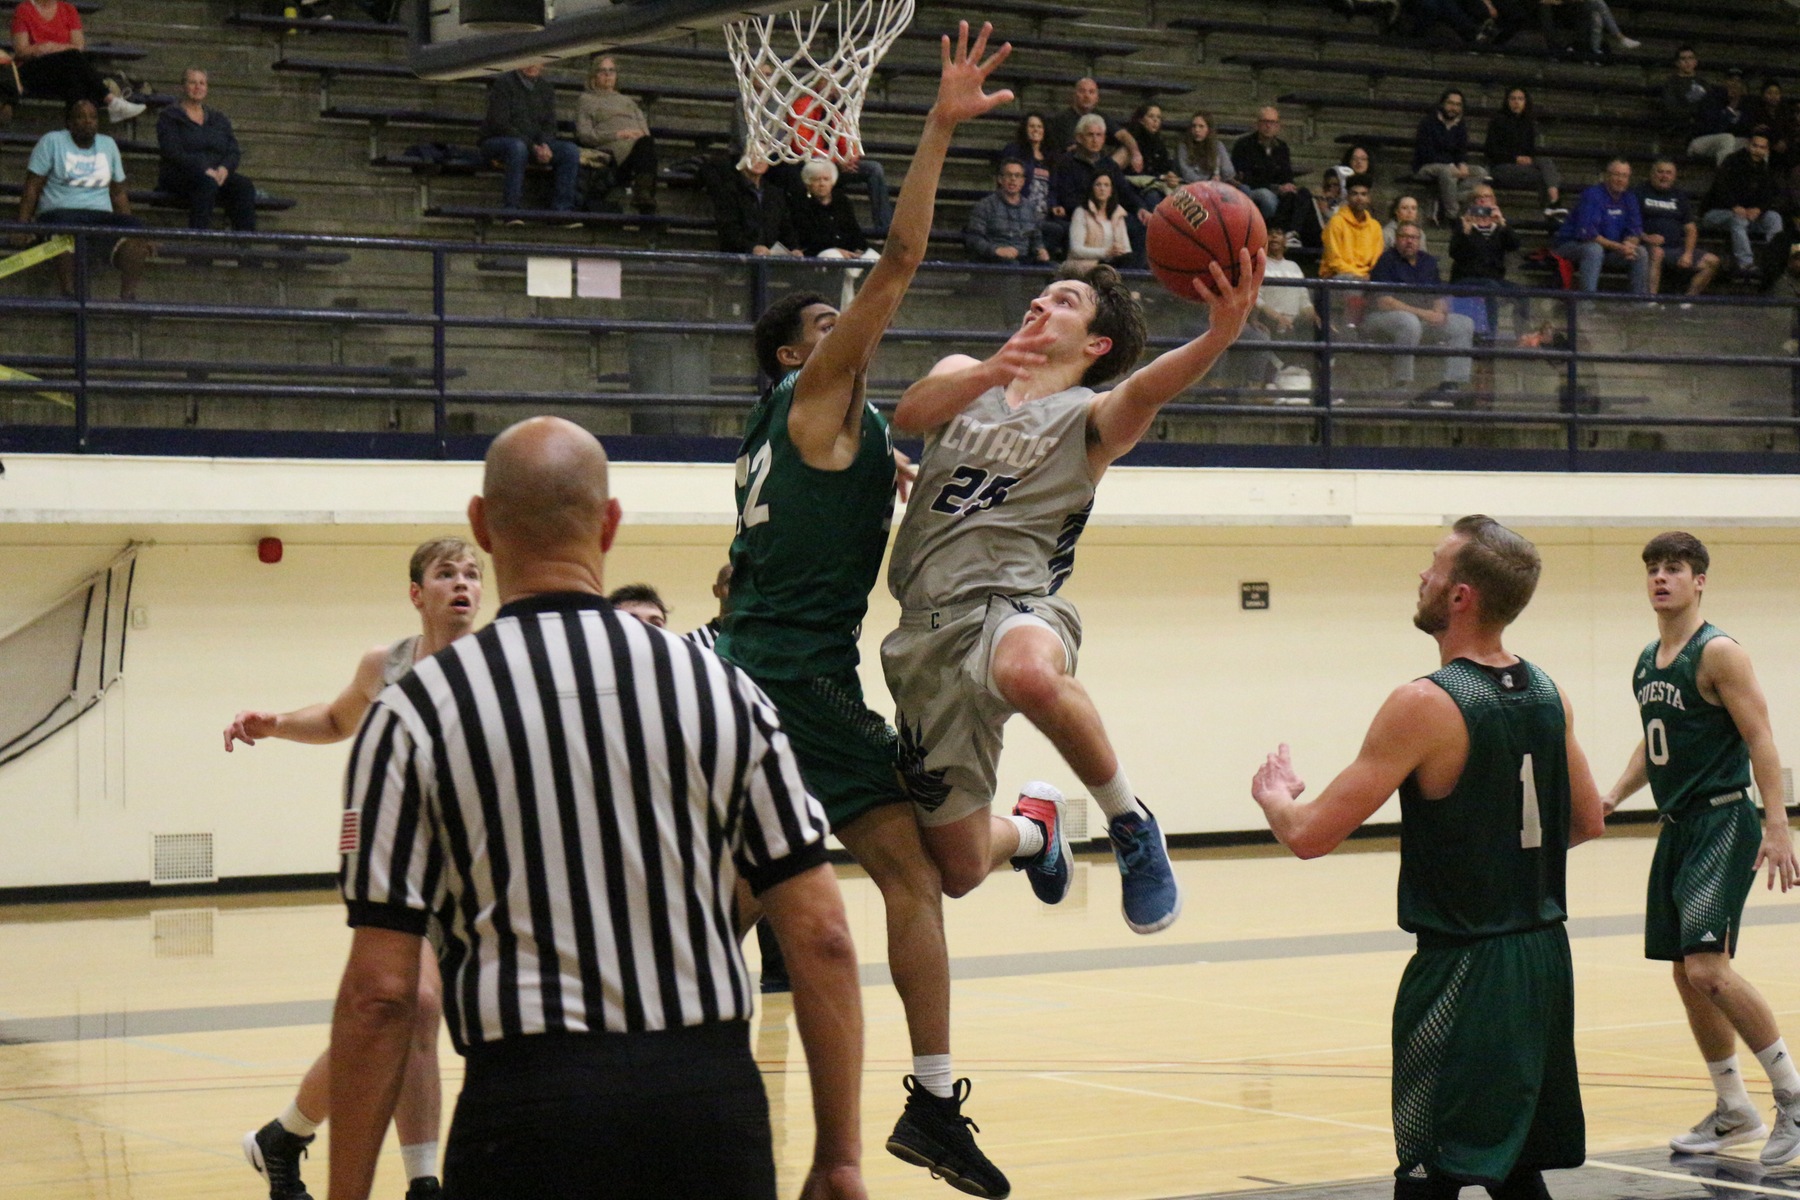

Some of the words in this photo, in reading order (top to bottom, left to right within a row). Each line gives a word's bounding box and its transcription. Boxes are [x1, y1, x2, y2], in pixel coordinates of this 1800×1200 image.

[940, 414, 1059, 468] CITRUS
[931, 612, 940, 629] C
[1638, 681, 1685, 711] CUESTA
[1647, 718, 1669, 765] 0
[1519, 753, 1542, 848] 1
